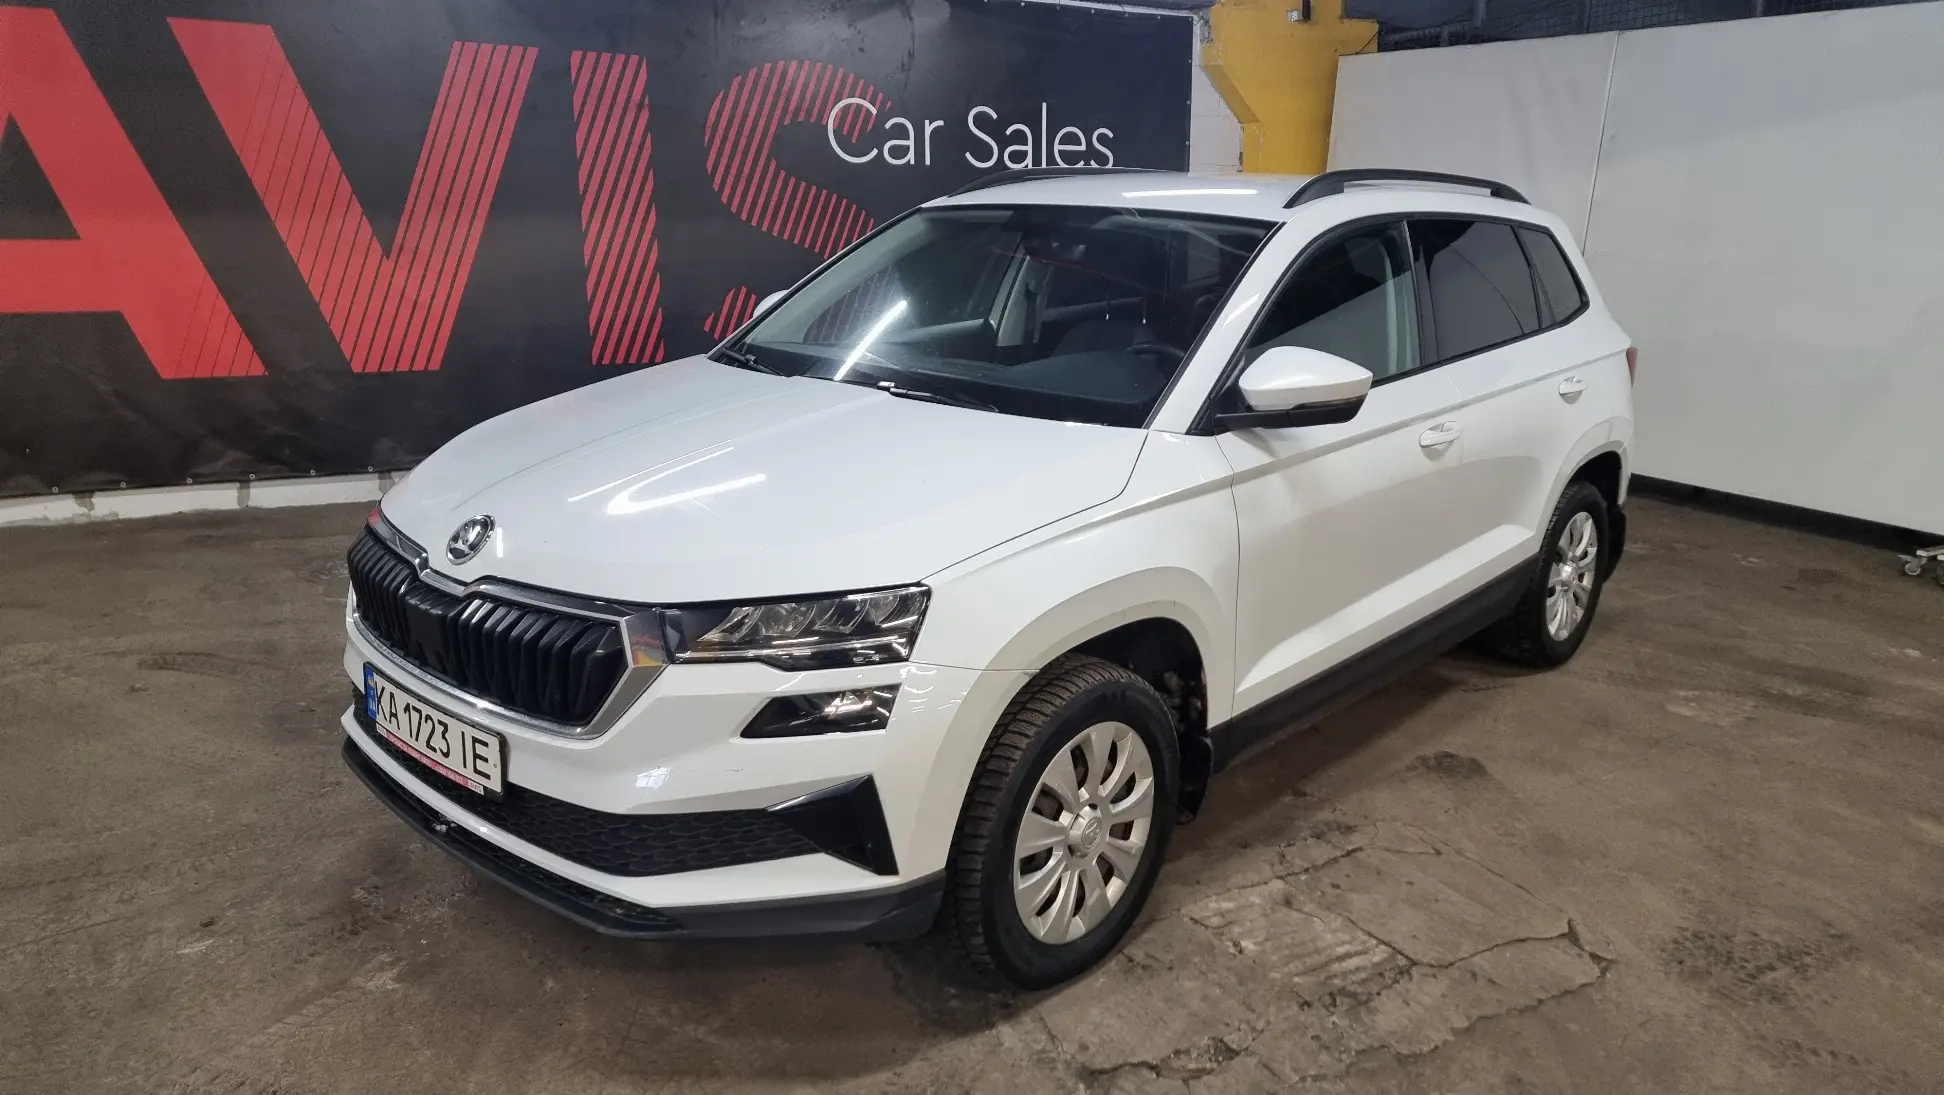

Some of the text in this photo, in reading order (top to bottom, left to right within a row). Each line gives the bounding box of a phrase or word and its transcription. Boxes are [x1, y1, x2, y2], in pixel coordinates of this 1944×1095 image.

[828, 97, 1114, 168] Car Sales
[375, 680, 400, 730] KA
[403, 702, 451, 758] 1723
[461, 730, 491, 780] IE
